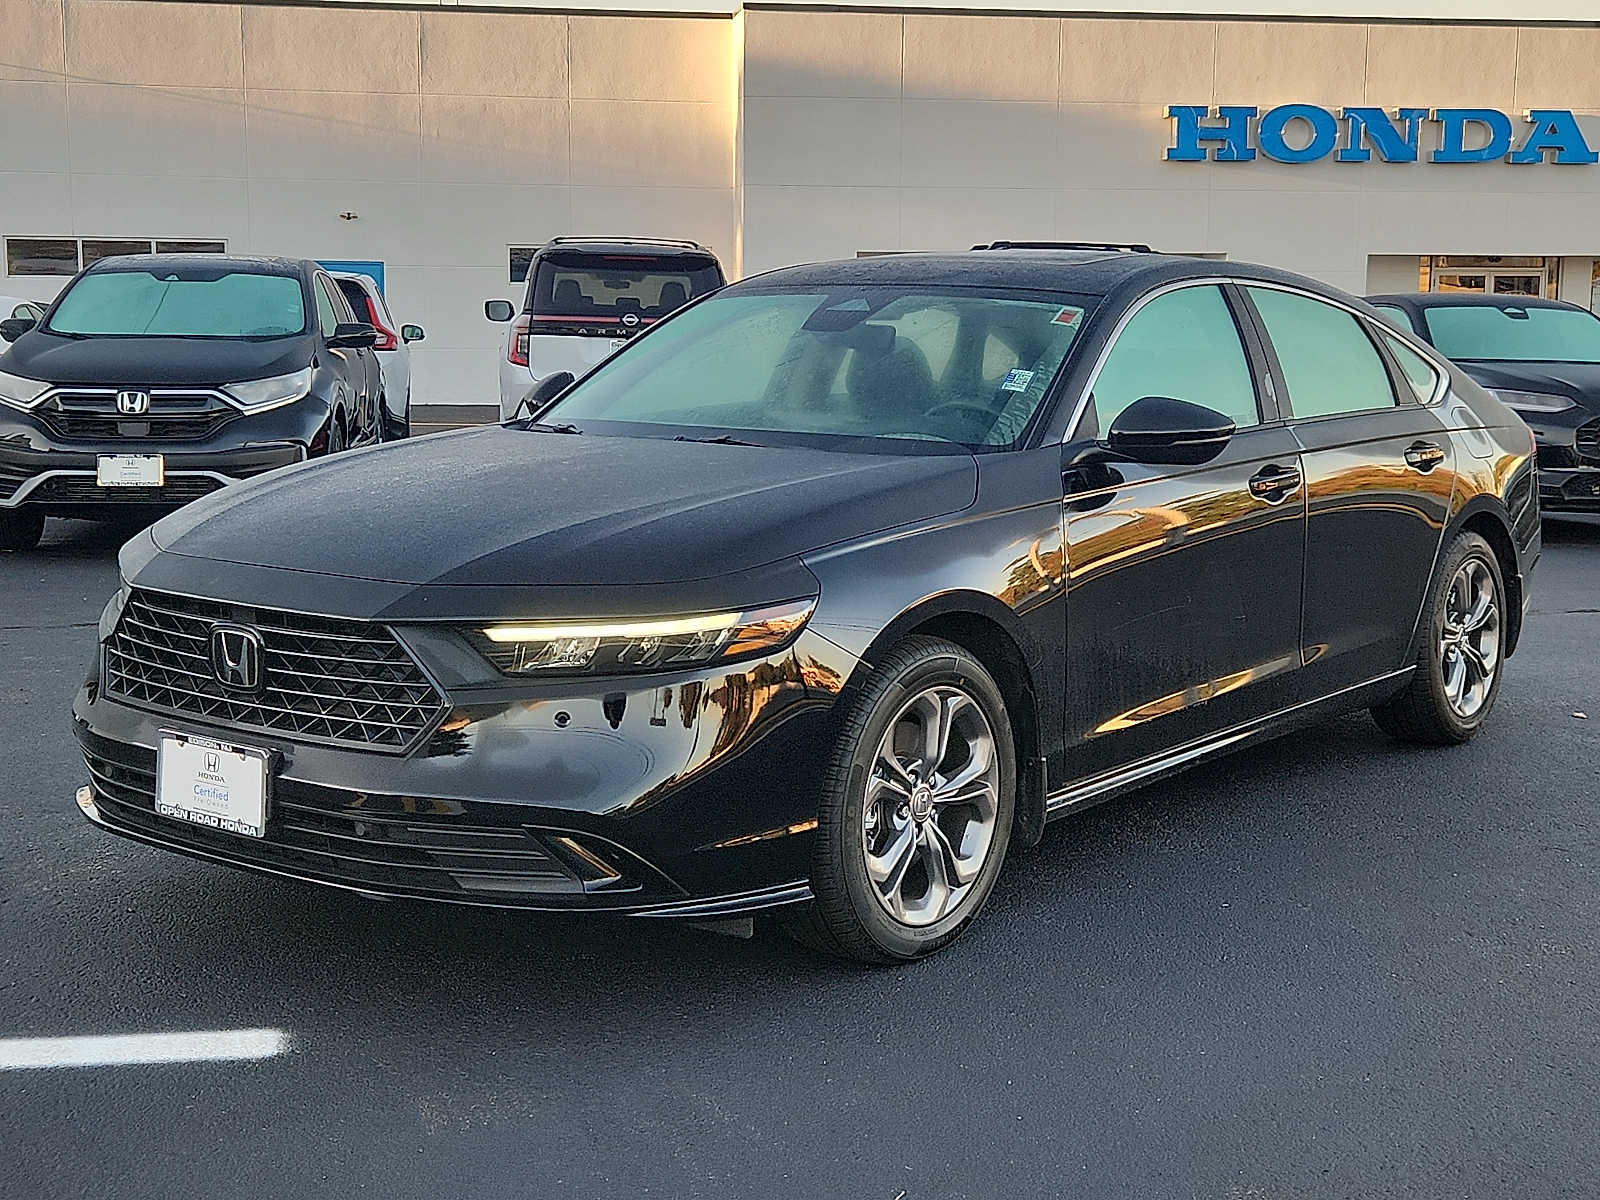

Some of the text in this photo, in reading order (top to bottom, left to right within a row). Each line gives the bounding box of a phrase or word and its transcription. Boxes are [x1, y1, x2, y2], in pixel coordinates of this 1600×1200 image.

[1164, 103, 1599, 164] HONDA
[198, 771, 225, 783] HONDA
[193, 784, 229, 801] Certified
[160, 804, 257, 837] OPEN ROAD HONDA
